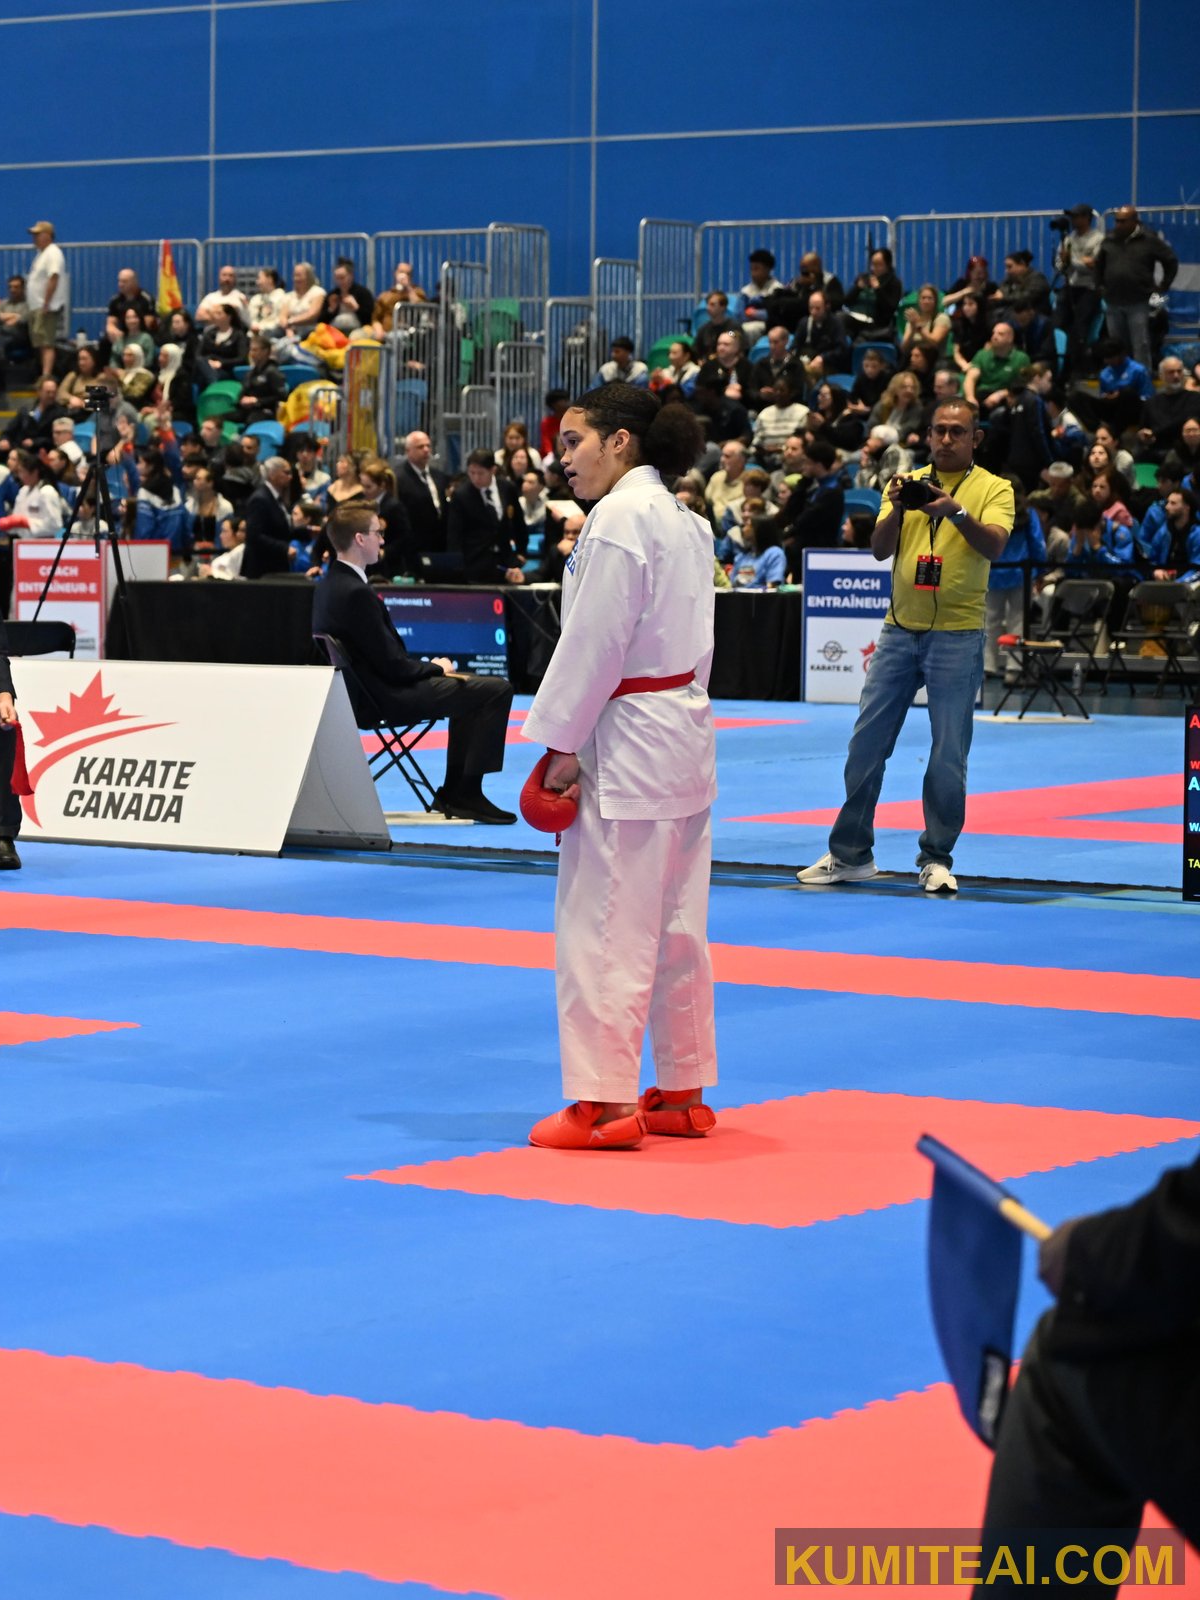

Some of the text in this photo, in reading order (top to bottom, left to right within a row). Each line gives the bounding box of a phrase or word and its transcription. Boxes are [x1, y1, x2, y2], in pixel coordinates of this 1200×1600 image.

[833, 578, 881, 591] COACH
[493, 599, 503, 614] 0
[495, 628, 506, 645] 0
[73, 756, 197, 790] KARATE
[63, 789, 184, 824] CANADA
